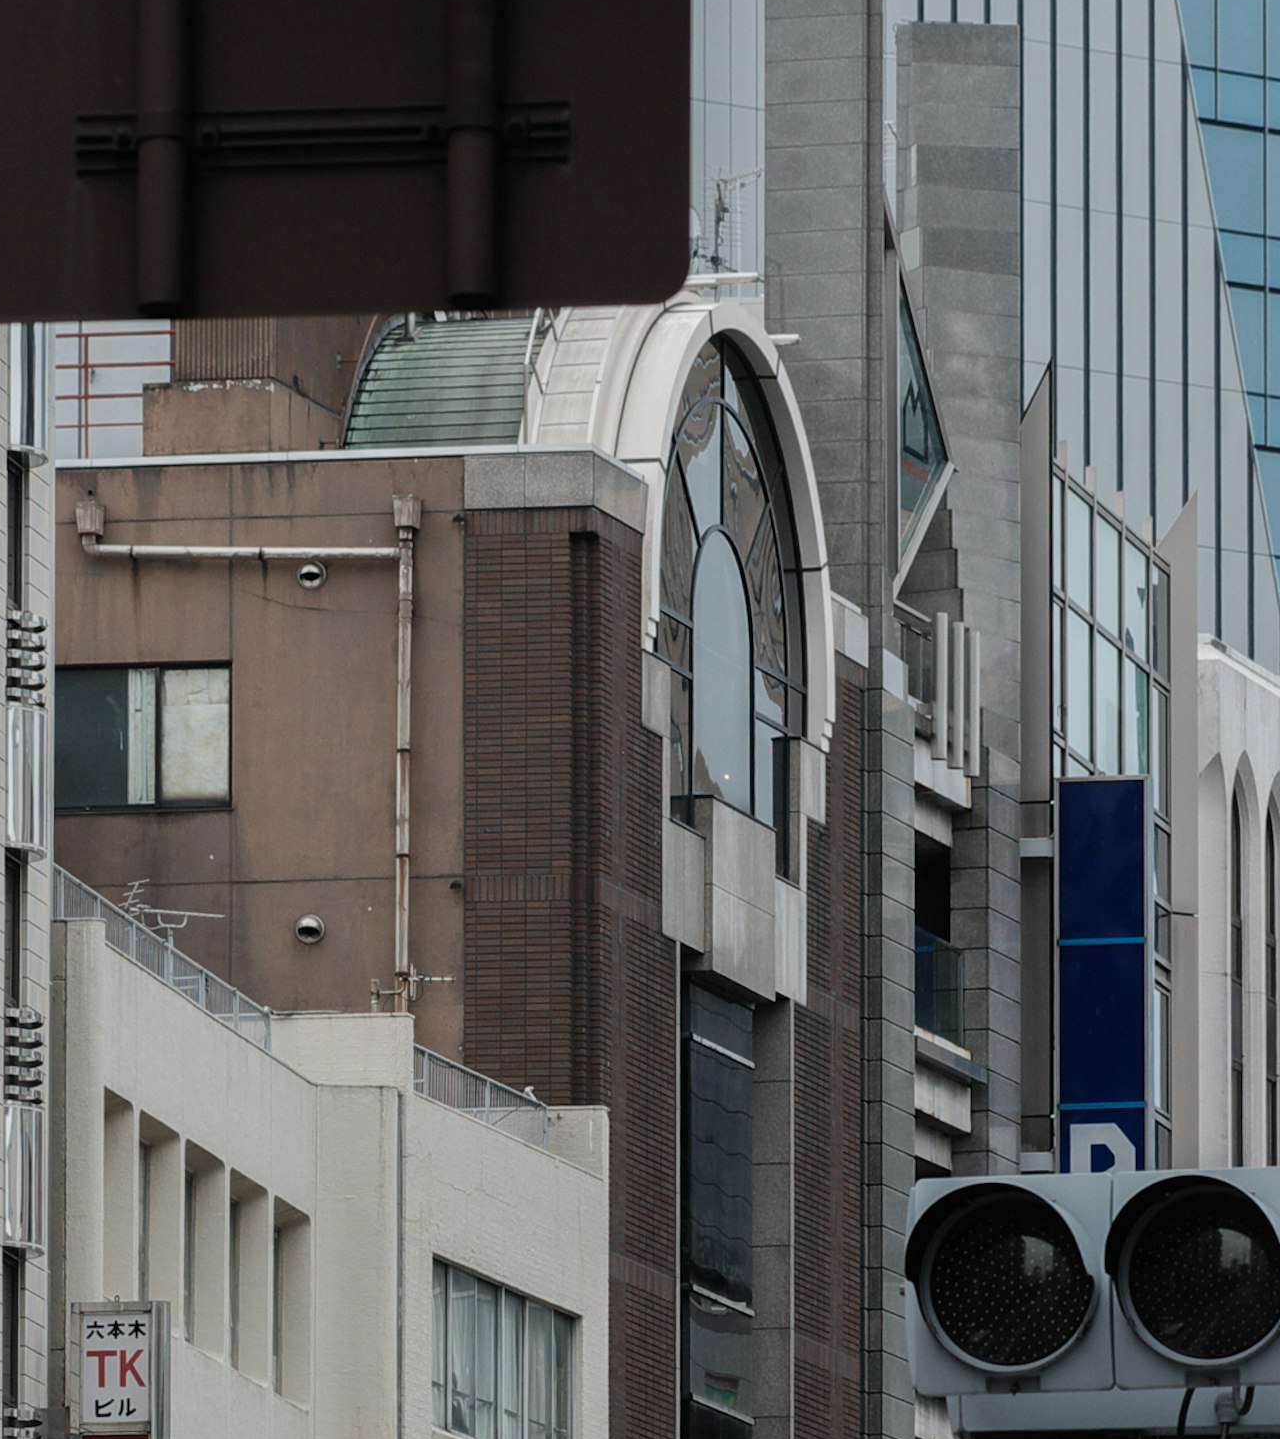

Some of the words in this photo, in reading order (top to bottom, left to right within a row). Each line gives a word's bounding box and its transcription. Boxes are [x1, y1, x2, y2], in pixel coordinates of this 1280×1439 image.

[86, 1321, 147, 1339] 六本木
[87, 1349, 147, 1389] TK
[94, 1397, 137, 1418] ビル
